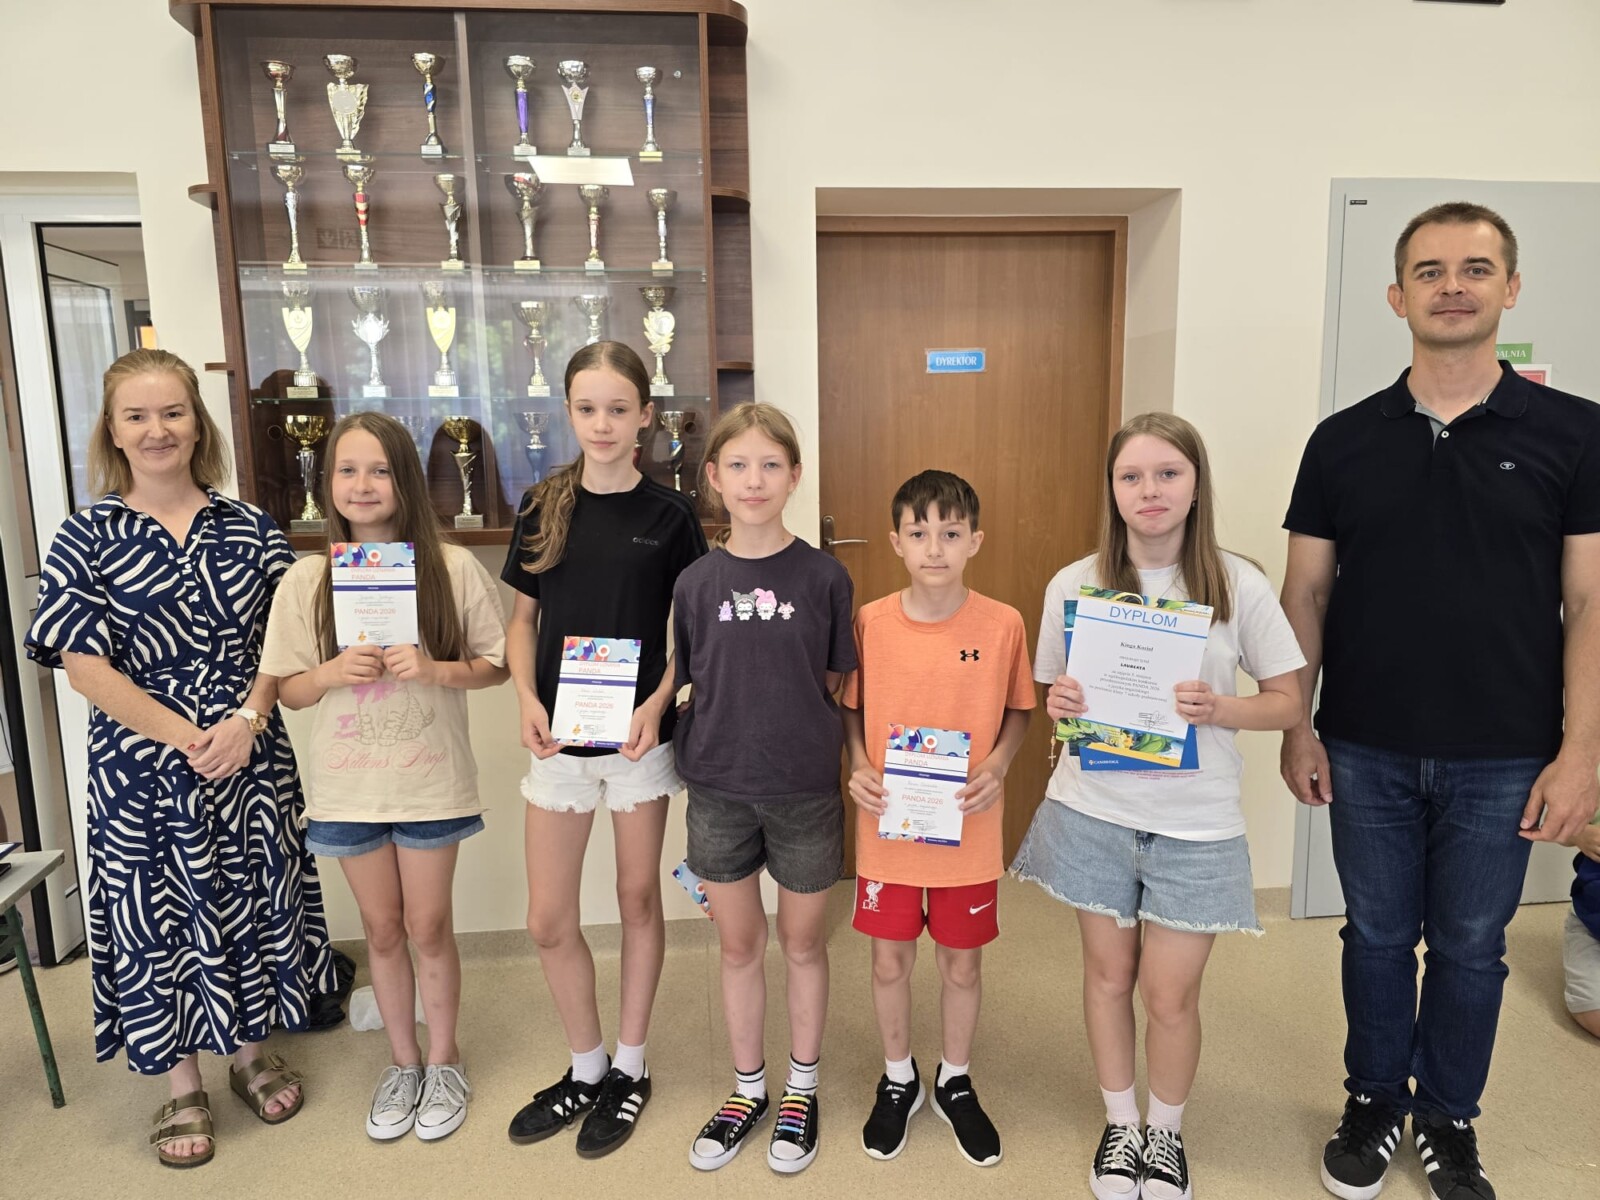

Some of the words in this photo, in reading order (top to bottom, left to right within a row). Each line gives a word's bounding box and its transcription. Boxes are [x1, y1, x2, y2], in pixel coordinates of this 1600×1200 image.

[935, 356, 977, 366] DYREKTOR
[1109, 606, 1178, 628] DYPLOM
[1120, 662, 1146, 671] LAUREATA
[575, 701, 598, 709] PANDA
[901, 794, 926, 802] PANDA
[927, 797, 944, 805] 2026
[861, 899, 880, 912] LFC
